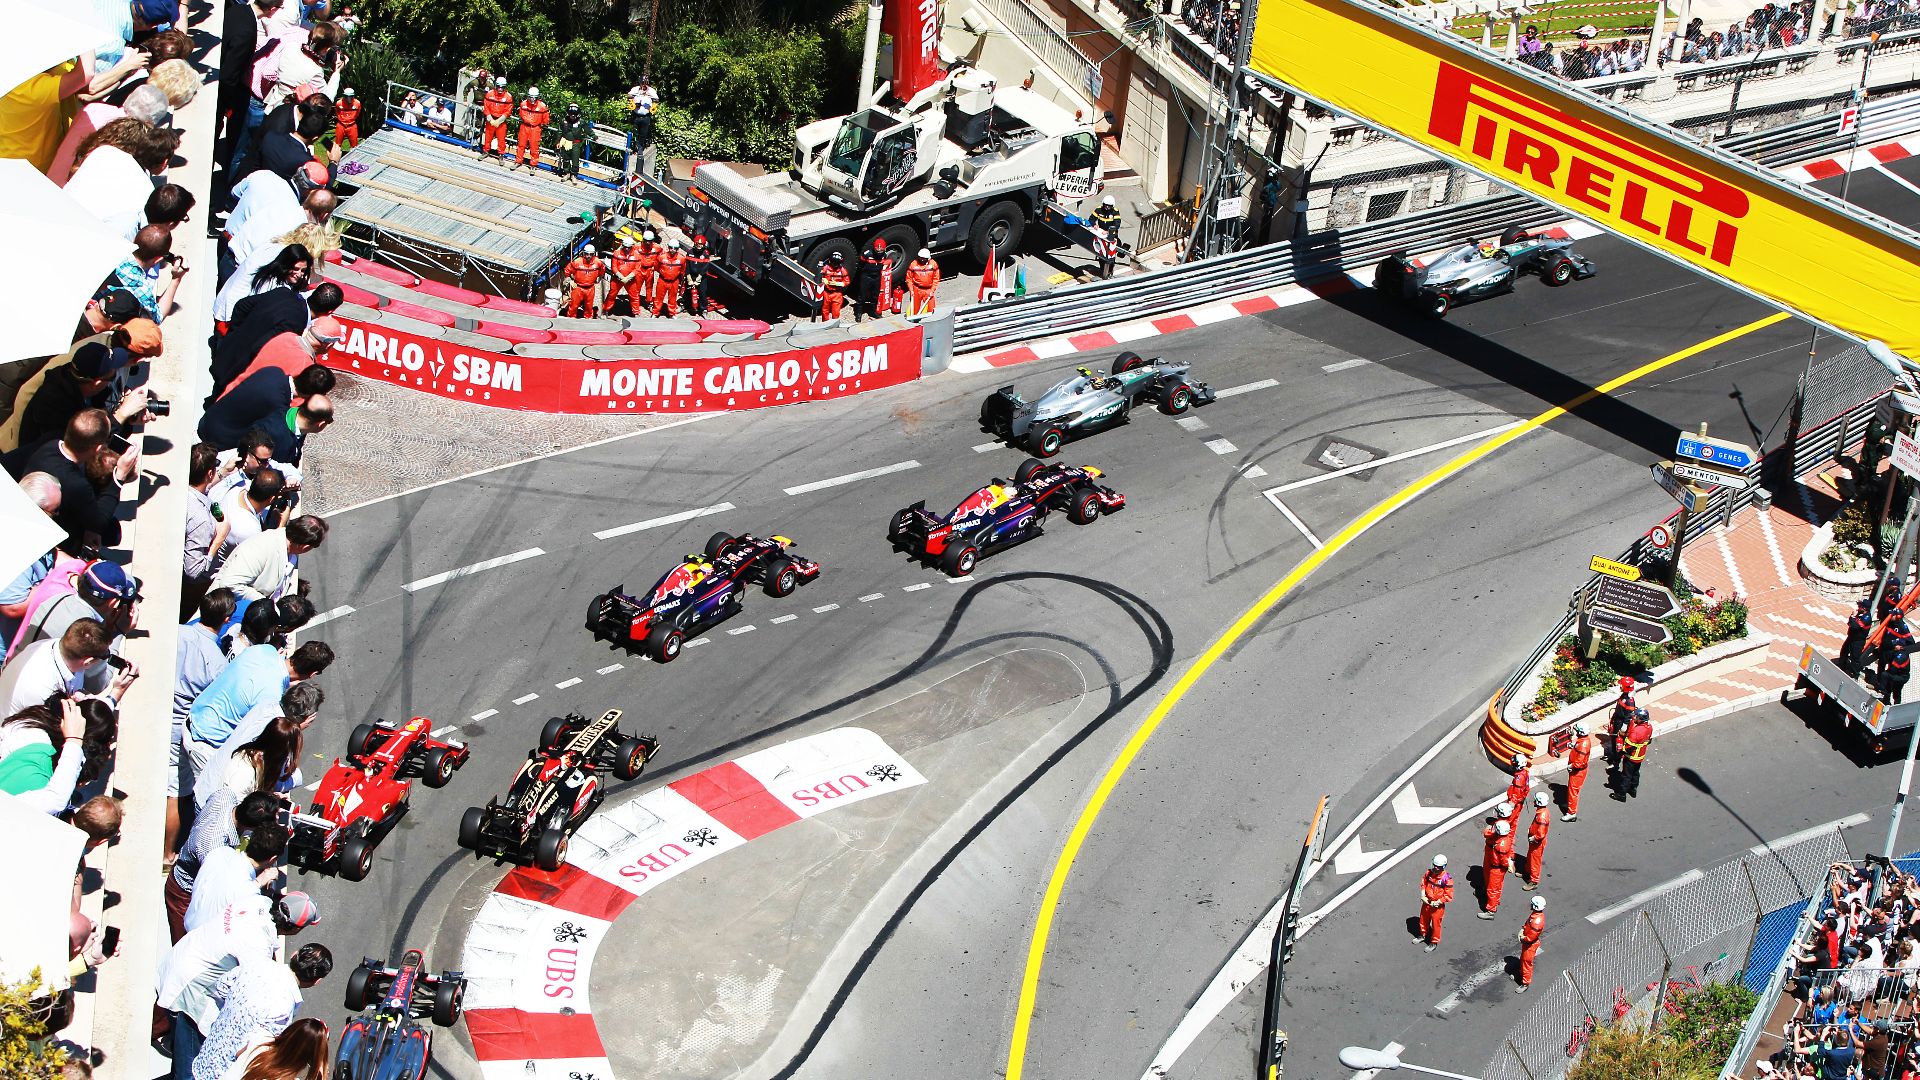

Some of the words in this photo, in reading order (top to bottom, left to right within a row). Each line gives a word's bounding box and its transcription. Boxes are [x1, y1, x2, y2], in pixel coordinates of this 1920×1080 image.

[1841, 110, 1856, 131] F
[1428, 60, 1750, 267] PIRELLI
[1055, 182, 1088, 194] LEVAGE
[452, 354, 522, 392] SBM
[580, 368, 694, 397] MONTE
[704, 359, 799, 394] CARLO
[827, 343, 888, 381] SBM
[384, 369, 490, 400] CASINOS
[608, 400, 702, 409] HOTELS
[760, 380, 862, 402] CASINOS
[1687, 470, 1720, 482] MENTON
[928, 530, 948, 540] TOTAL
[952, 519, 980, 530] RENAULT
[1593, 560, 1606, 568] QUAI
[1608, 564, 1630, 575] ANTOINE
[632, 614, 650, 626] TOTAL
[654, 599, 680, 614] RENAULT
[526, 780, 544, 812] CLEAR
[539, 791, 560, 816] RENAULT
[792, 774, 872, 807] UBS
[619, 842, 693, 884] UBS
[544, 948, 578, 998] UBS
